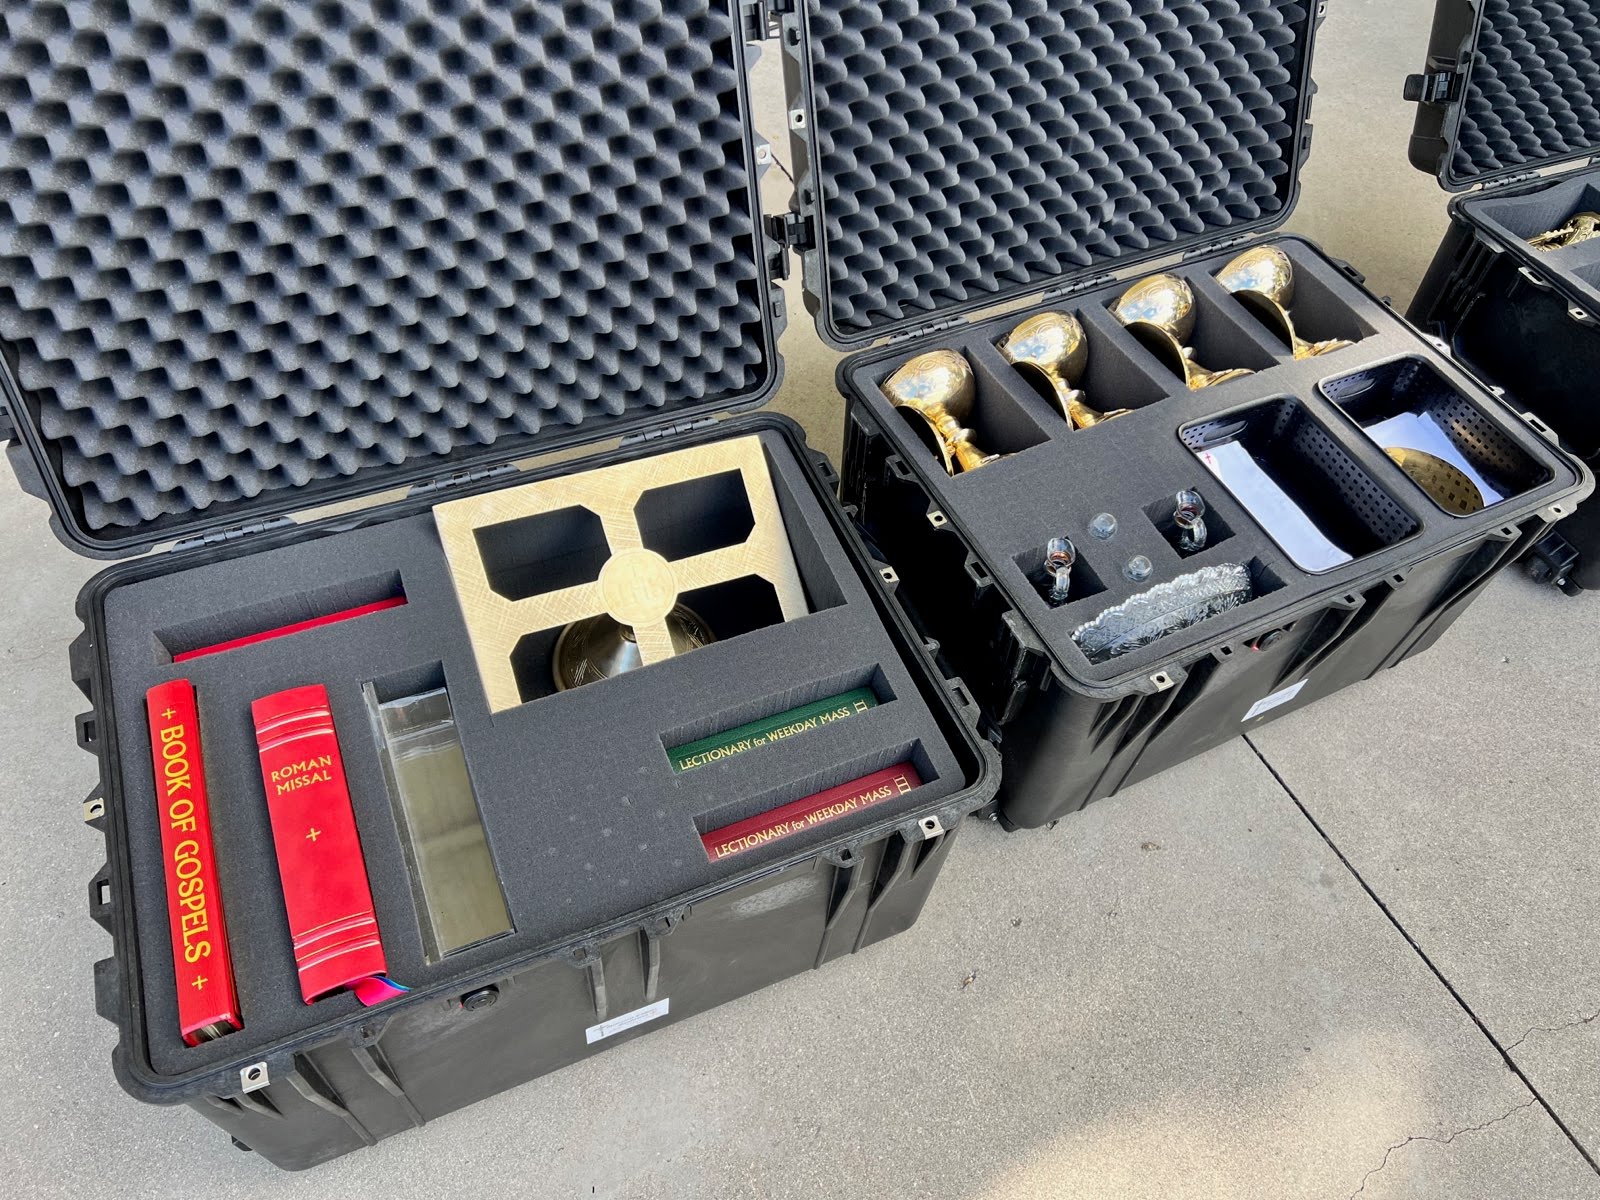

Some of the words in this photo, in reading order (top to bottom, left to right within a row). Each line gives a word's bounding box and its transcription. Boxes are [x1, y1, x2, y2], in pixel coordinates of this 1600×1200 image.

[160, 724, 191, 796] BOOK
[271, 755, 332, 783] ROMAN
[679, 739, 751, 770] LECTIONARY
[753, 736, 766, 748] for
[766, 718, 817, 742] WEEKDAY
[819, 706, 850, 725] MASS
[853, 700, 868, 714] II
[169, 799, 196, 833] OF
[276, 772, 332, 795] MISSAL
[715, 822, 790, 858] LECTIONARY
[791, 818, 805, 831] for
[804, 799, 858, 825] WEEKDAY
[859, 785, 892, 805] MASS
[894, 774, 912, 795] III
[174, 840, 211, 963] GOSPELS
